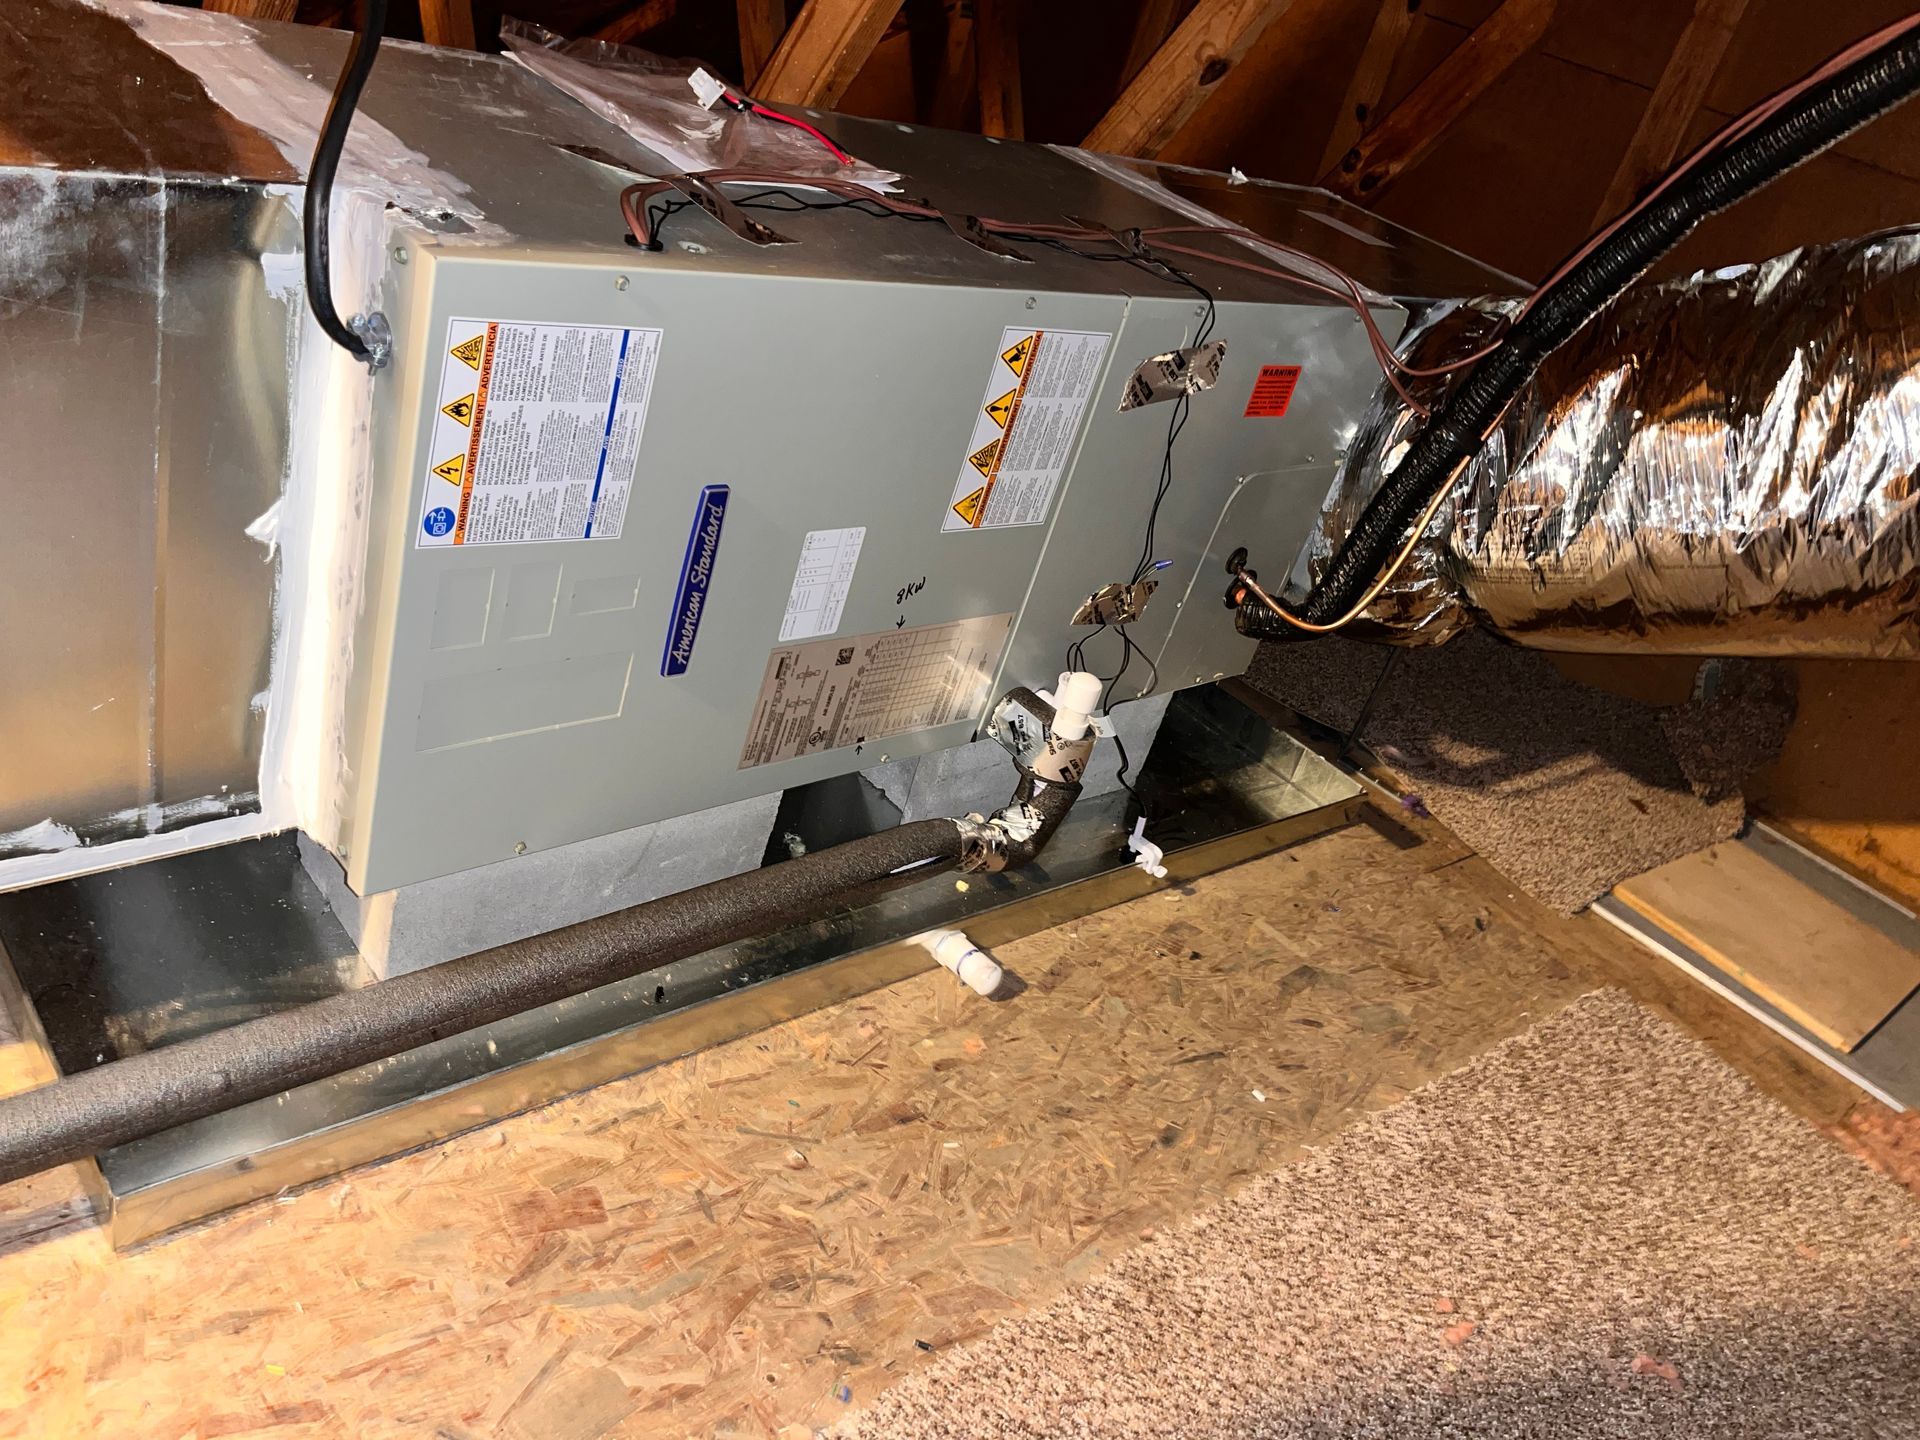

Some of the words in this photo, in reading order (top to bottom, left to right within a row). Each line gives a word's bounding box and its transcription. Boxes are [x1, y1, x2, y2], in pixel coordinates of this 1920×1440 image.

[480, 324, 497, 388] ADVERTENCIA
[509, 328, 518, 356] LESIONES
[513, 331, 523, 369] DESCONECTE
[519, 343, 527, 368] FUENTES
[496, 360, 506, 391] DESCARGA
[1021, 334, 1042, 387] ADVERTENCIA
[1262, 368, 1298, 376] WARNING
[527, 365, 536, 396] DESCARGA
[532, 362, 542, 401] CAPACITORES
[467, 403, 484, 473] AVERTISSEMENT
[506, 423, 514, 443] TOUTES
[996, 404, 1020, 463] AVERTISSEMENT
[506, 443, 517, 484] ALIMENTATIONS
[513, 430, 525, 476] CONDENSATEURS
[488, 460, 496, 484] POUVANT
[494, 454, 503, 484] BLESSURES
[457, 492, 470, 530] WARNING
[500, 494, 508, 518] ELECTRIC
[510, 499, 518, 528] DISCHARGE
[978, 482, 994, 514] WARNING
[490, 509, 499, 540] DISCONNECT
[514, 508, 523, 539] CAPACITORS
[672, 592, 704, 665] American
[690, 502, 724, 589] Standard
